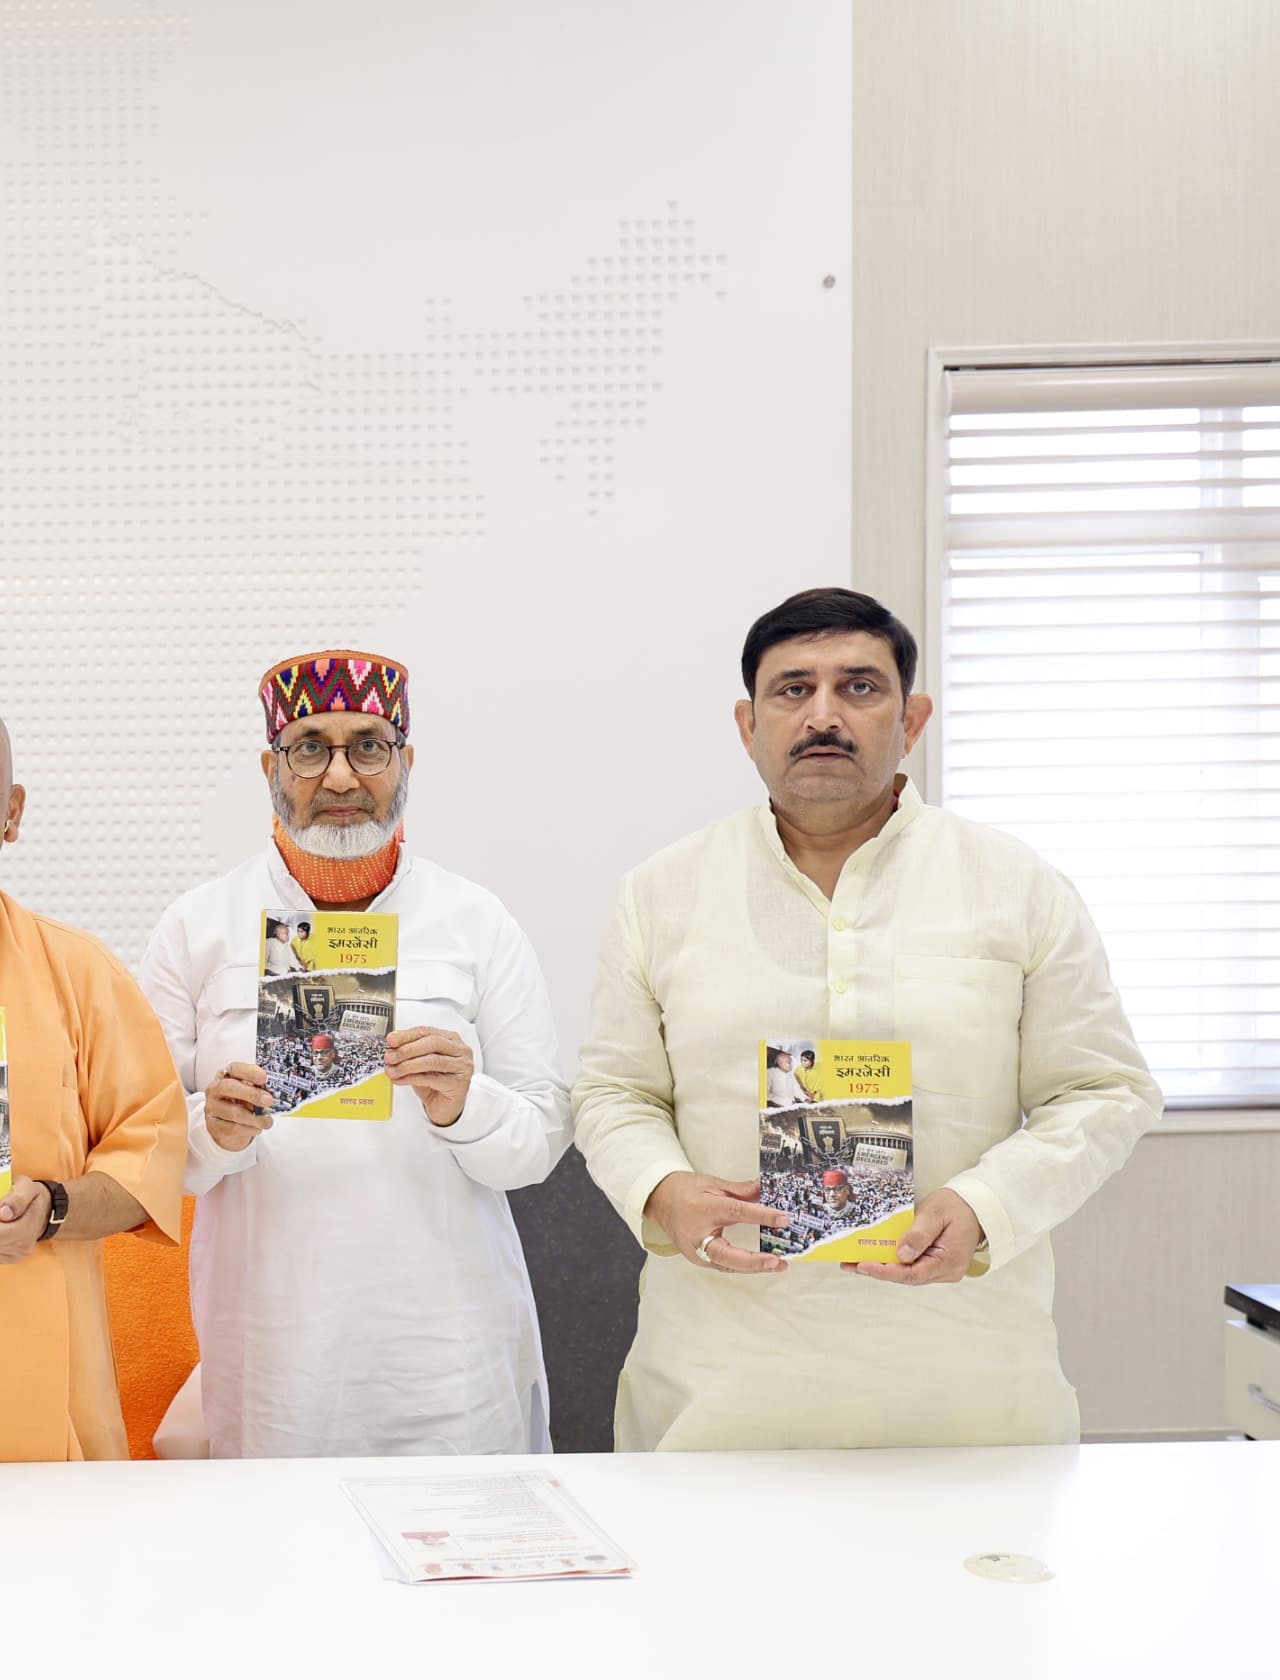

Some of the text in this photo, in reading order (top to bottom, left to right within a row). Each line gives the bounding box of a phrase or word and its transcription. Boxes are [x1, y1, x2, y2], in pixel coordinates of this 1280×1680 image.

[327, 936, 378, 949] इमरजेंसी
[340, 953, 367, 964] 1975
[342, 1021, 372, 1031] DECLARED
[343, 1017, 376, 1028] EMERGENCY
[835, 1064, 891, 1078] इमरजेंसी
[849, 1082, 880, 1094] 1975
